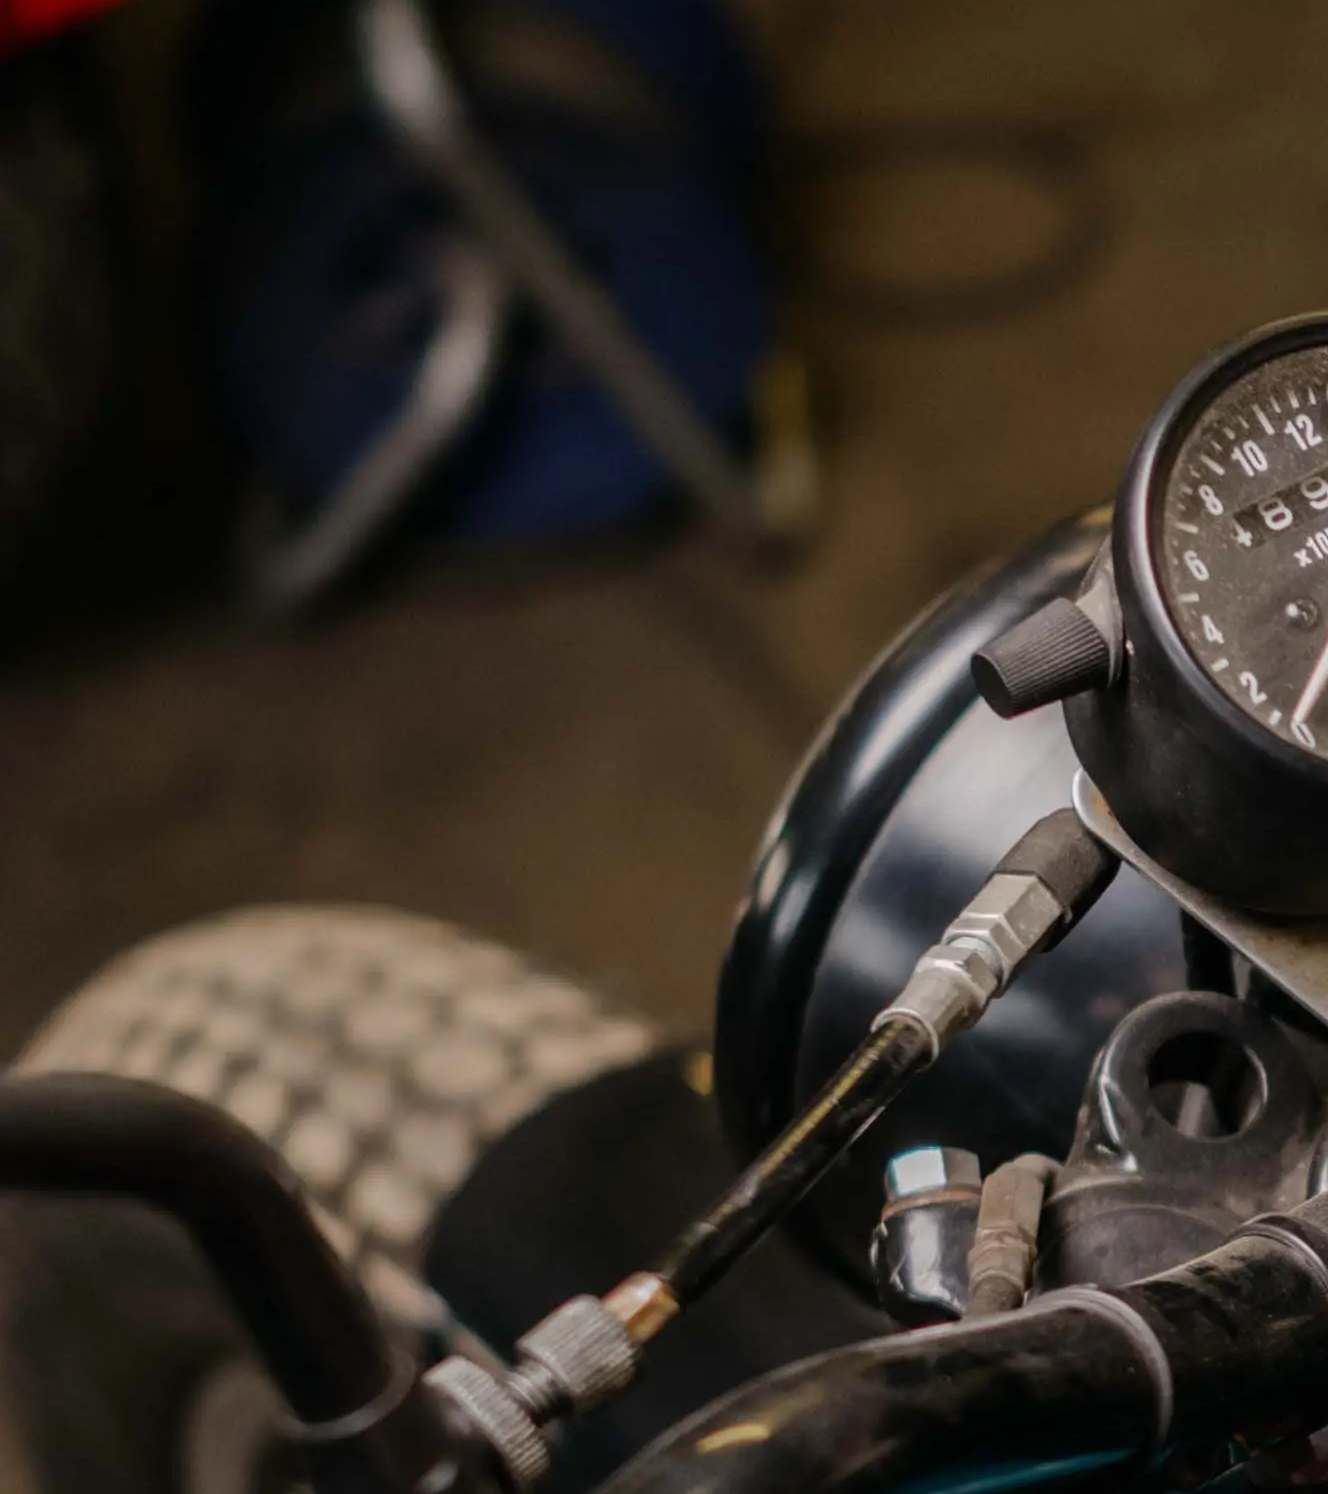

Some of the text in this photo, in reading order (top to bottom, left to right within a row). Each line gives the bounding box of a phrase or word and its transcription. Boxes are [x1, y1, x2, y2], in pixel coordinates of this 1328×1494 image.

[1284, 414, 1323, 451] 12
[1231, 440, 1268, 477] 10
[1198, 484, 1224, 516] 8
[1184, 550, 1210, 581] 6
[1201, 615, 1225, 644] 4
[1239, 671, 1268, 705] 2
